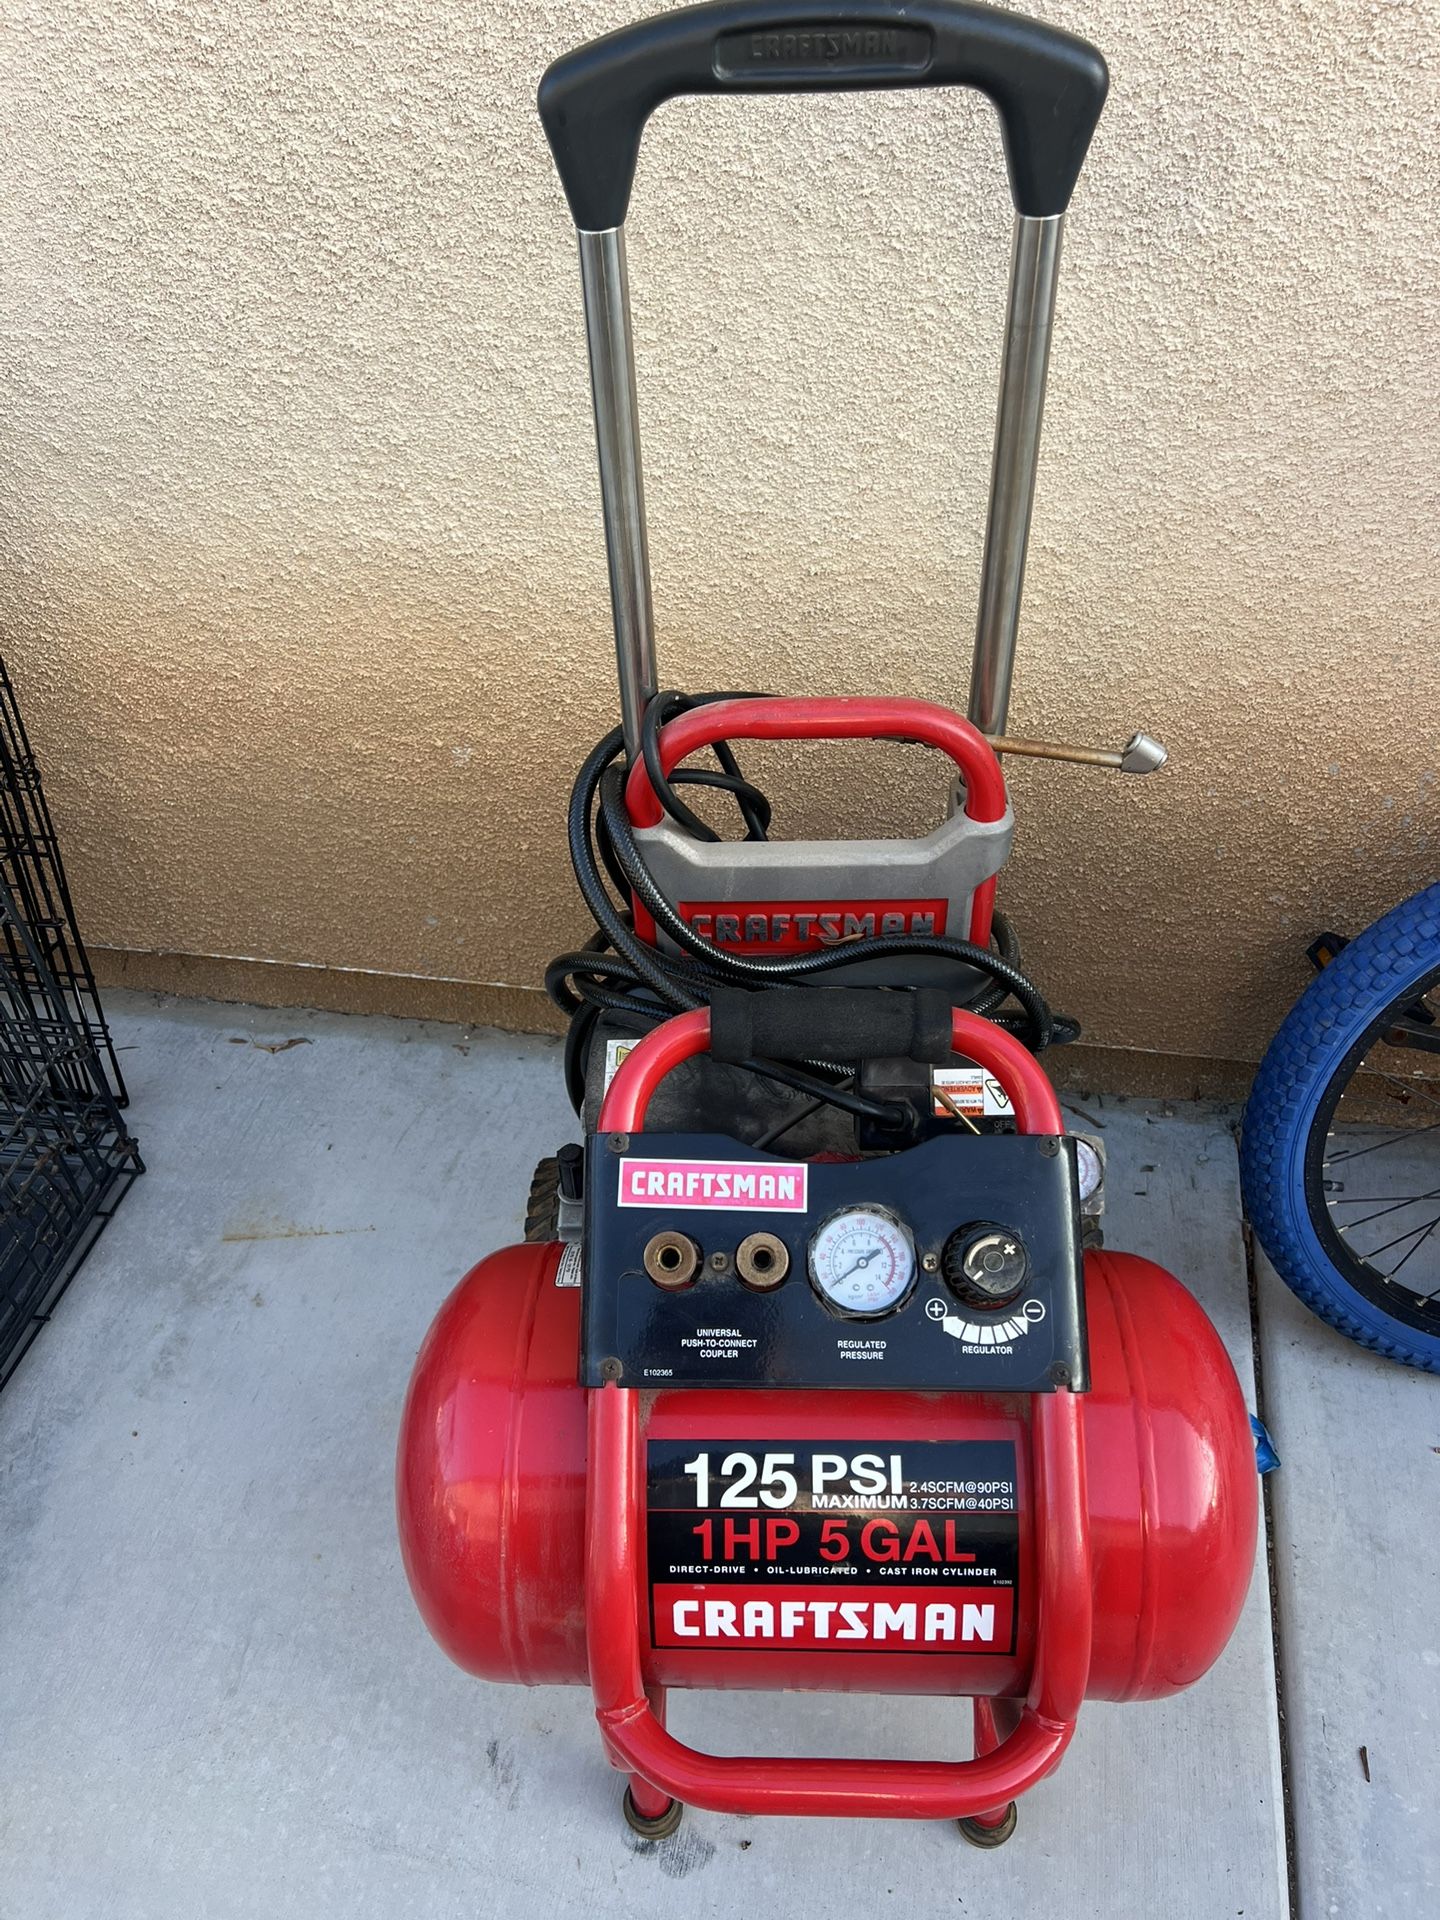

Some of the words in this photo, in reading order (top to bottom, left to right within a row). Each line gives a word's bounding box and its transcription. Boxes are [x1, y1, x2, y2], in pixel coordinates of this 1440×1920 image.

[752, 31, 896, 57] CRAFTSMAN
[691, 912, 935, 943] CRAFTSMAN
[631, 1170, 796, 1200] CRAFTSMAN
[697, 1329, 742, 1337] UNIVERSAL
[681, 1339, 757, 1348] PUSH-TO-CONNECT
[837, 1340, 886, 1349] REGULATED
[700, 1350, 738, 1358] COUPLER
[840, 1351, 884, 1360] PRESSURE
[962, 1345, 1013, 1355] REGULATOR
[643, 1368, 673, 1377] E102365
[684, 1452, 798, 1509] 125
[812, 1454, 903, 1495] PSI
[909, 1481, 1013, 1493] 2.4SCFM@90PSI
[812, 1495, 907, 1509] MAXIMUM
[910, 1498, 1014, 1510] 3.7SCFM@40PSI
[692, 1518, 800, 1561] 1HP
[819, 1519, 850, 1562] 5
[860, 1519, 976, 1562] GAL
[669, 1565, 746, 1574] DIRECT-DRIVE
[767, 1566, 858, 1575] OIL-LUBRICATED
[879, 1567, 908, 1575] CAST
[911, 1568, 938, 1576] IRON
[942, 1568, 997, 1576] CYLINDER
[672, 1599, 995, 1642] CRAFTSMAN
